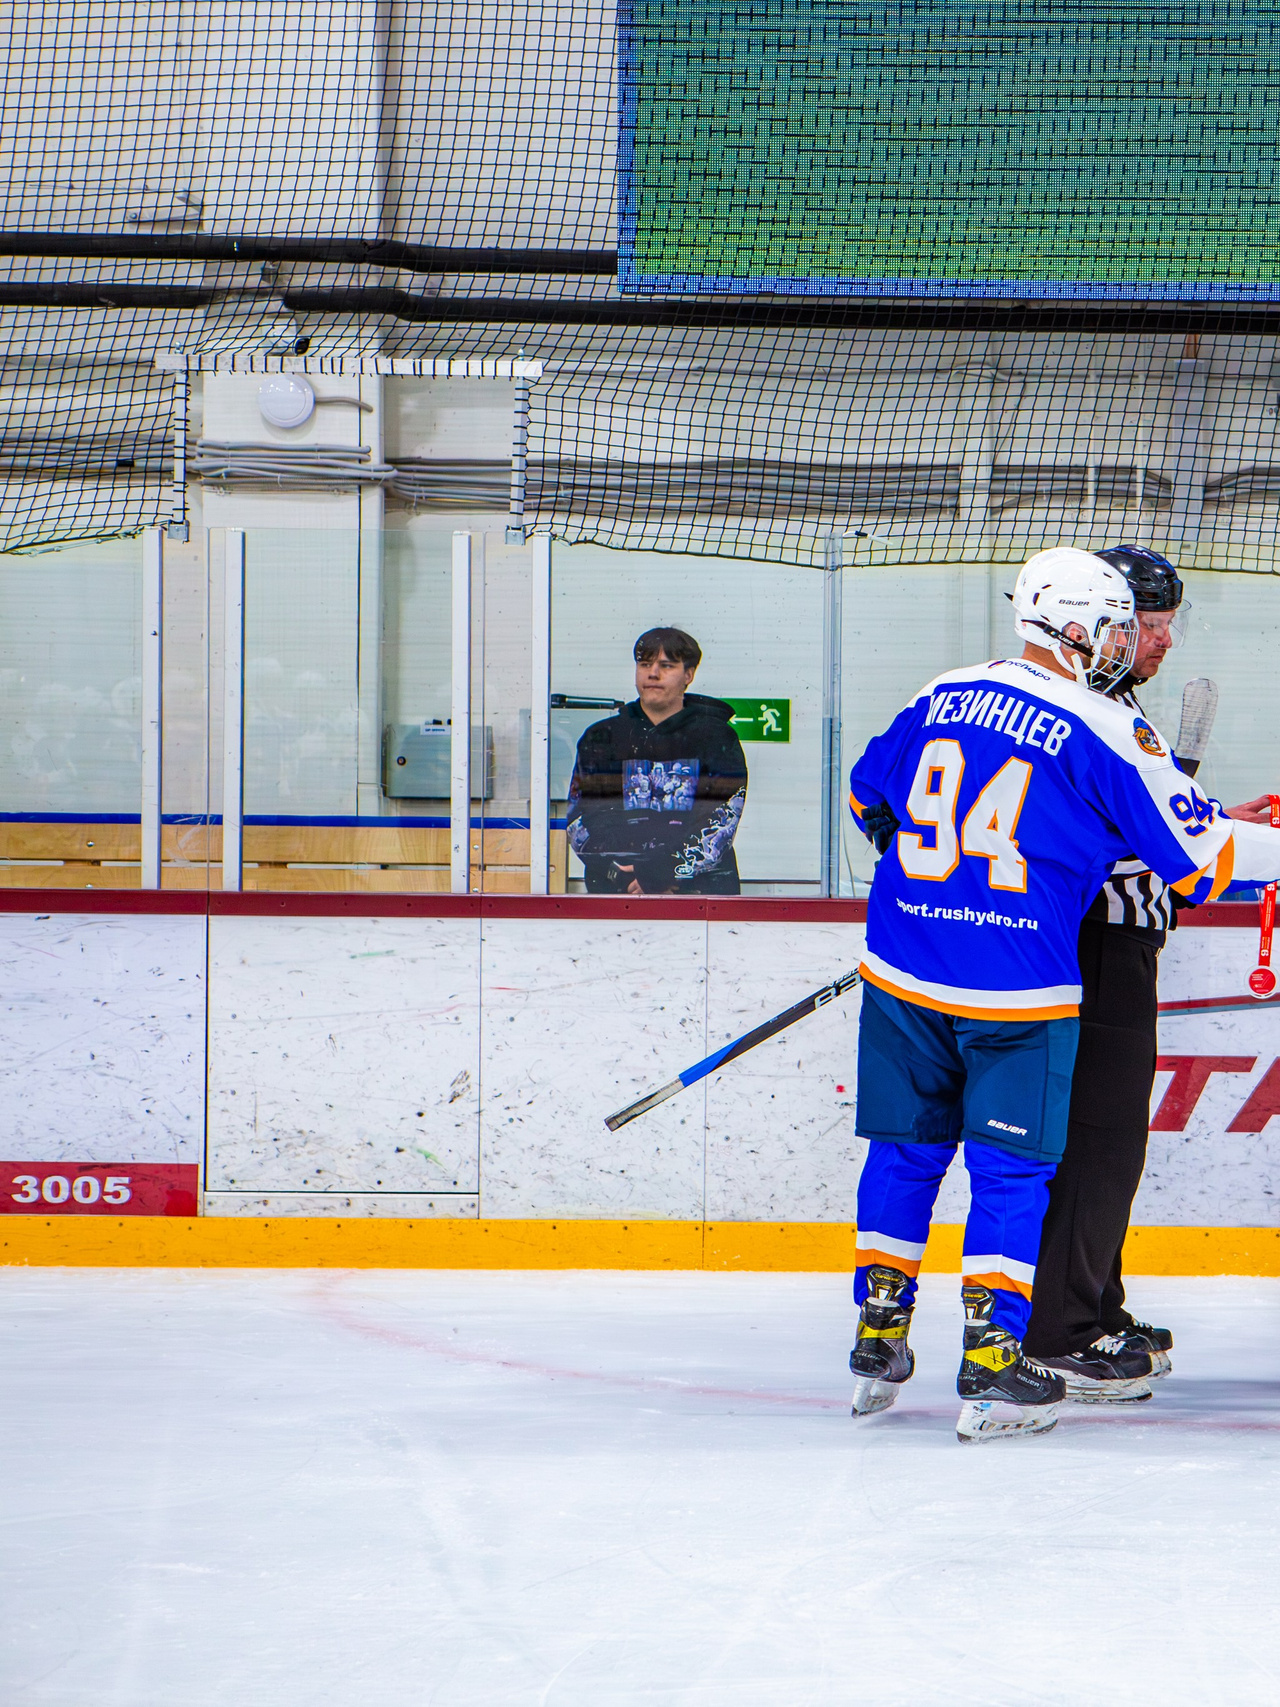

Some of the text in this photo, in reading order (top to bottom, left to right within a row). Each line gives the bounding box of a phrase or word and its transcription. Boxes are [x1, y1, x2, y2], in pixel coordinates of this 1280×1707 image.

[897, 738, 1033, 894] 94
[1168, 786, 1215, 838] 94
[987, 1119, 1027, 1136] BAUER
[11, 1175, 131, 1204] 3005
